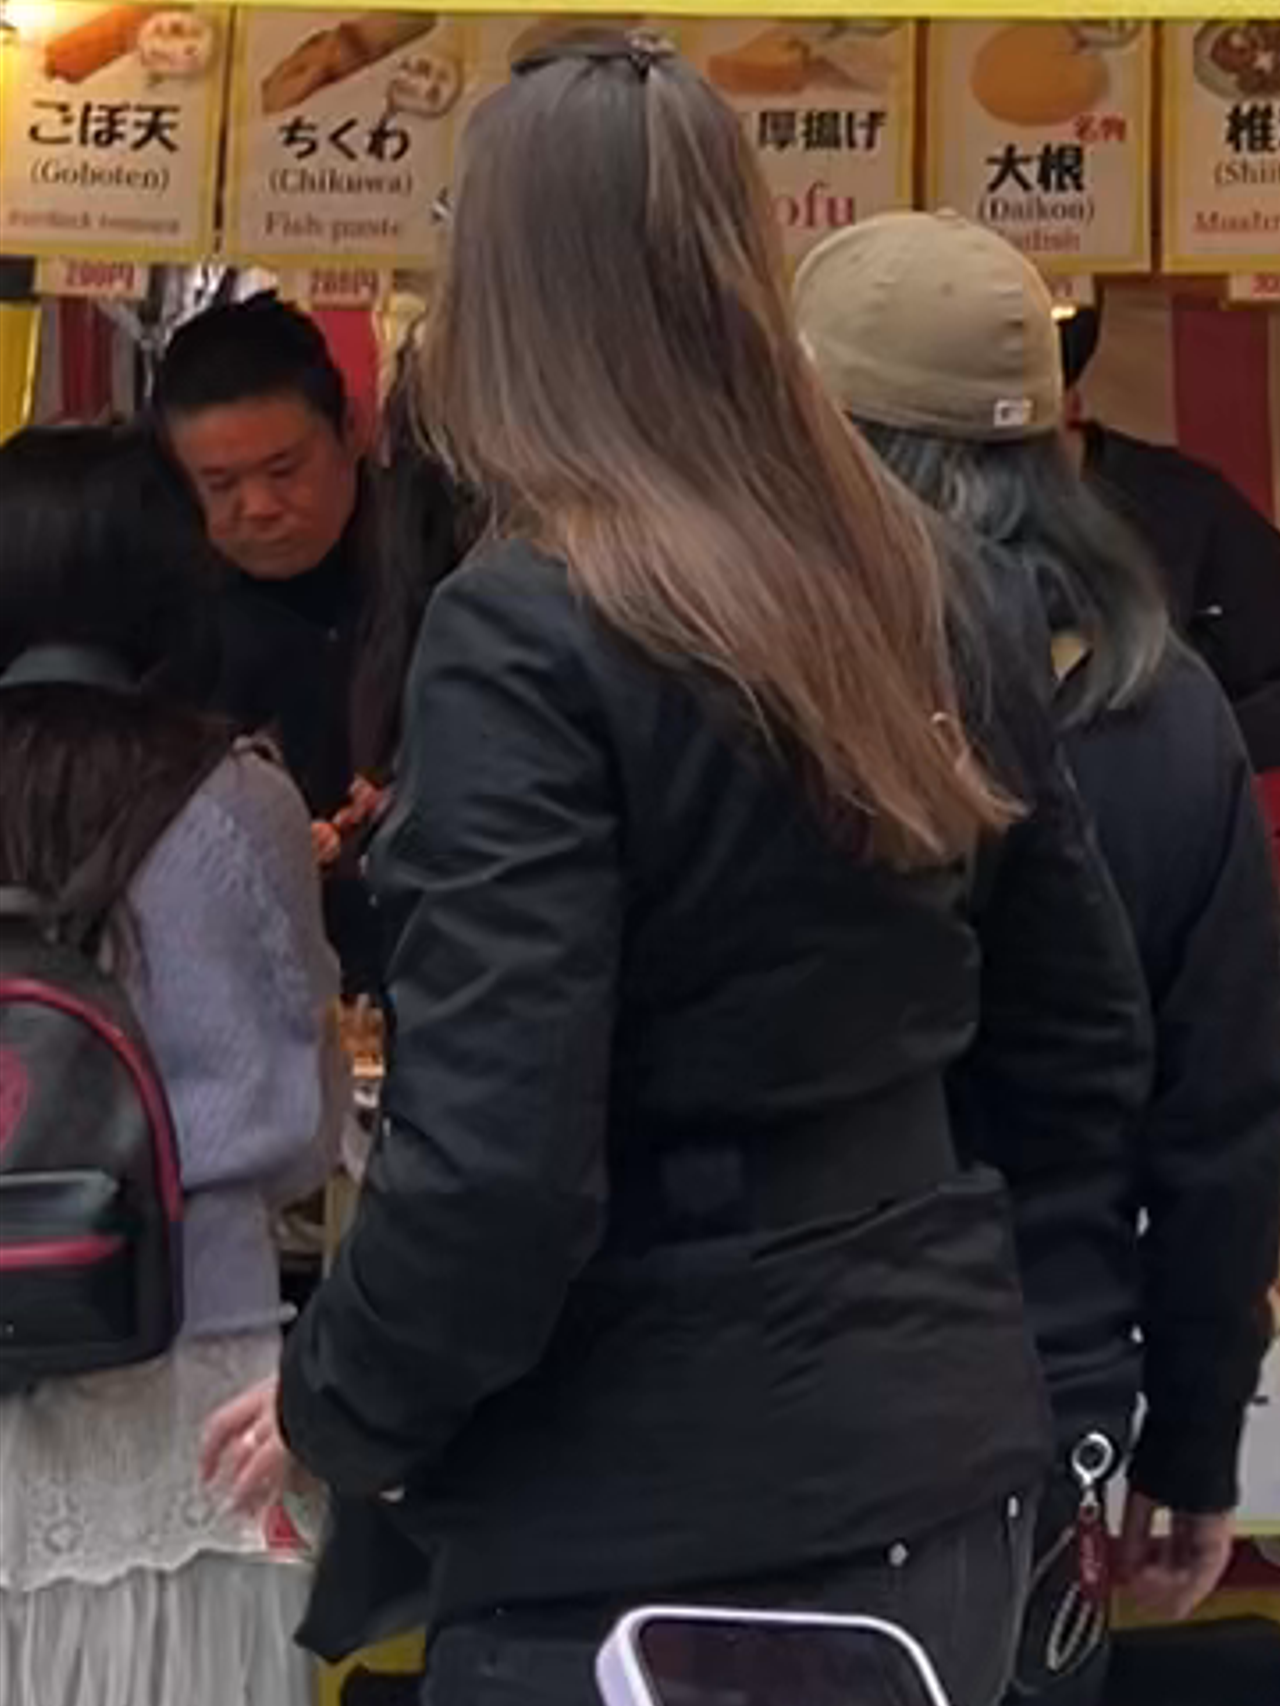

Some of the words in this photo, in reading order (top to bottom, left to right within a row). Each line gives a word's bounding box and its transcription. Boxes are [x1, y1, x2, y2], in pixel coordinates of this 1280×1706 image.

[279, 116, 410, 162] ちくわ
[757, 109, 887, 152] 厚揚げ
[986, 143, 1087, 193] 大根
[768, 180, 856, 228] ofu
[977, 196, 1096, 226] (Daikon)
